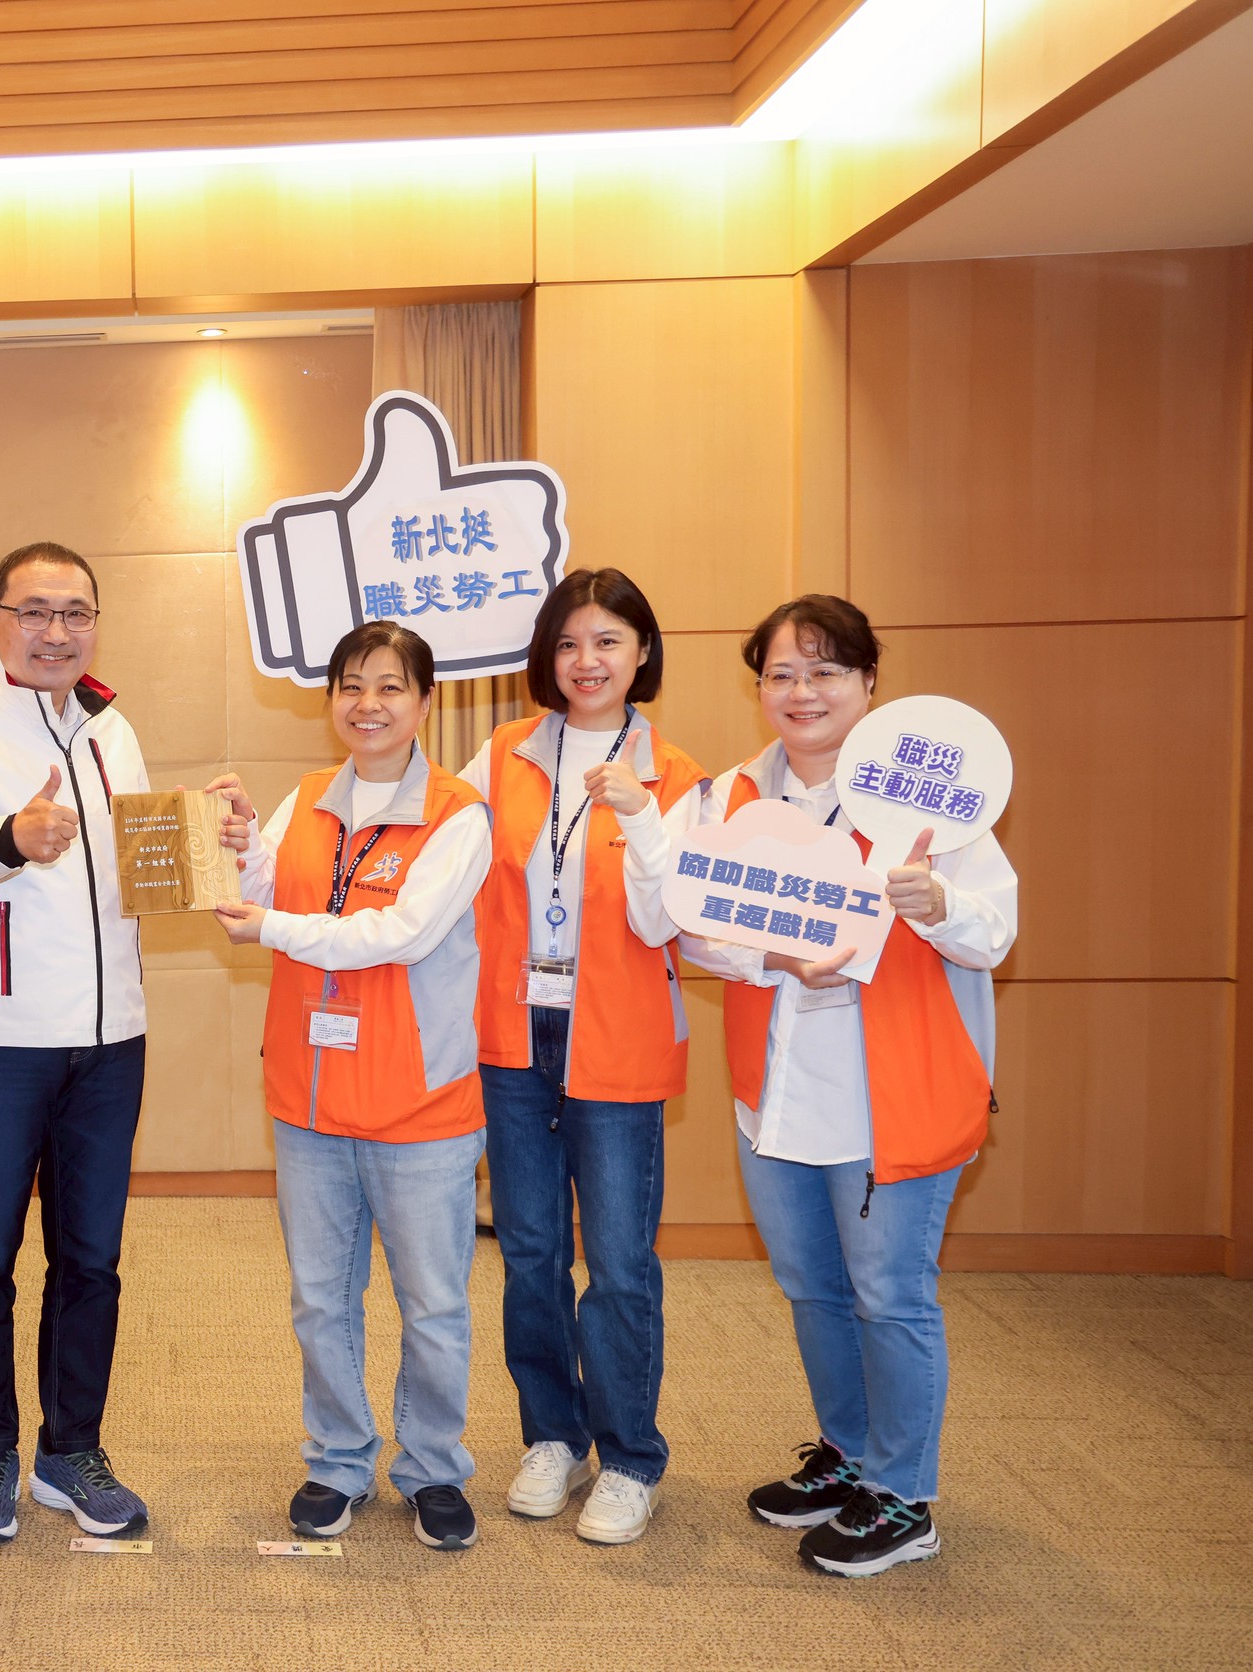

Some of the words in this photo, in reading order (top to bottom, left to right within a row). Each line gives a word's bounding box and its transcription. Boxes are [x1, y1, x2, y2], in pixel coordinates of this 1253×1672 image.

[391, 507, 498, 563] 新北挺
[363, 569, 543, 620] 職災勞工
[894, 735, 961, 776] 職災
[851, 762, 983, 821] 主動服務
[354, 882, 399, 896] 新北市政府勞工
[677, 850, 882, 918] 協助職災勞工
[700, 895, 838, 947] 重返職場
